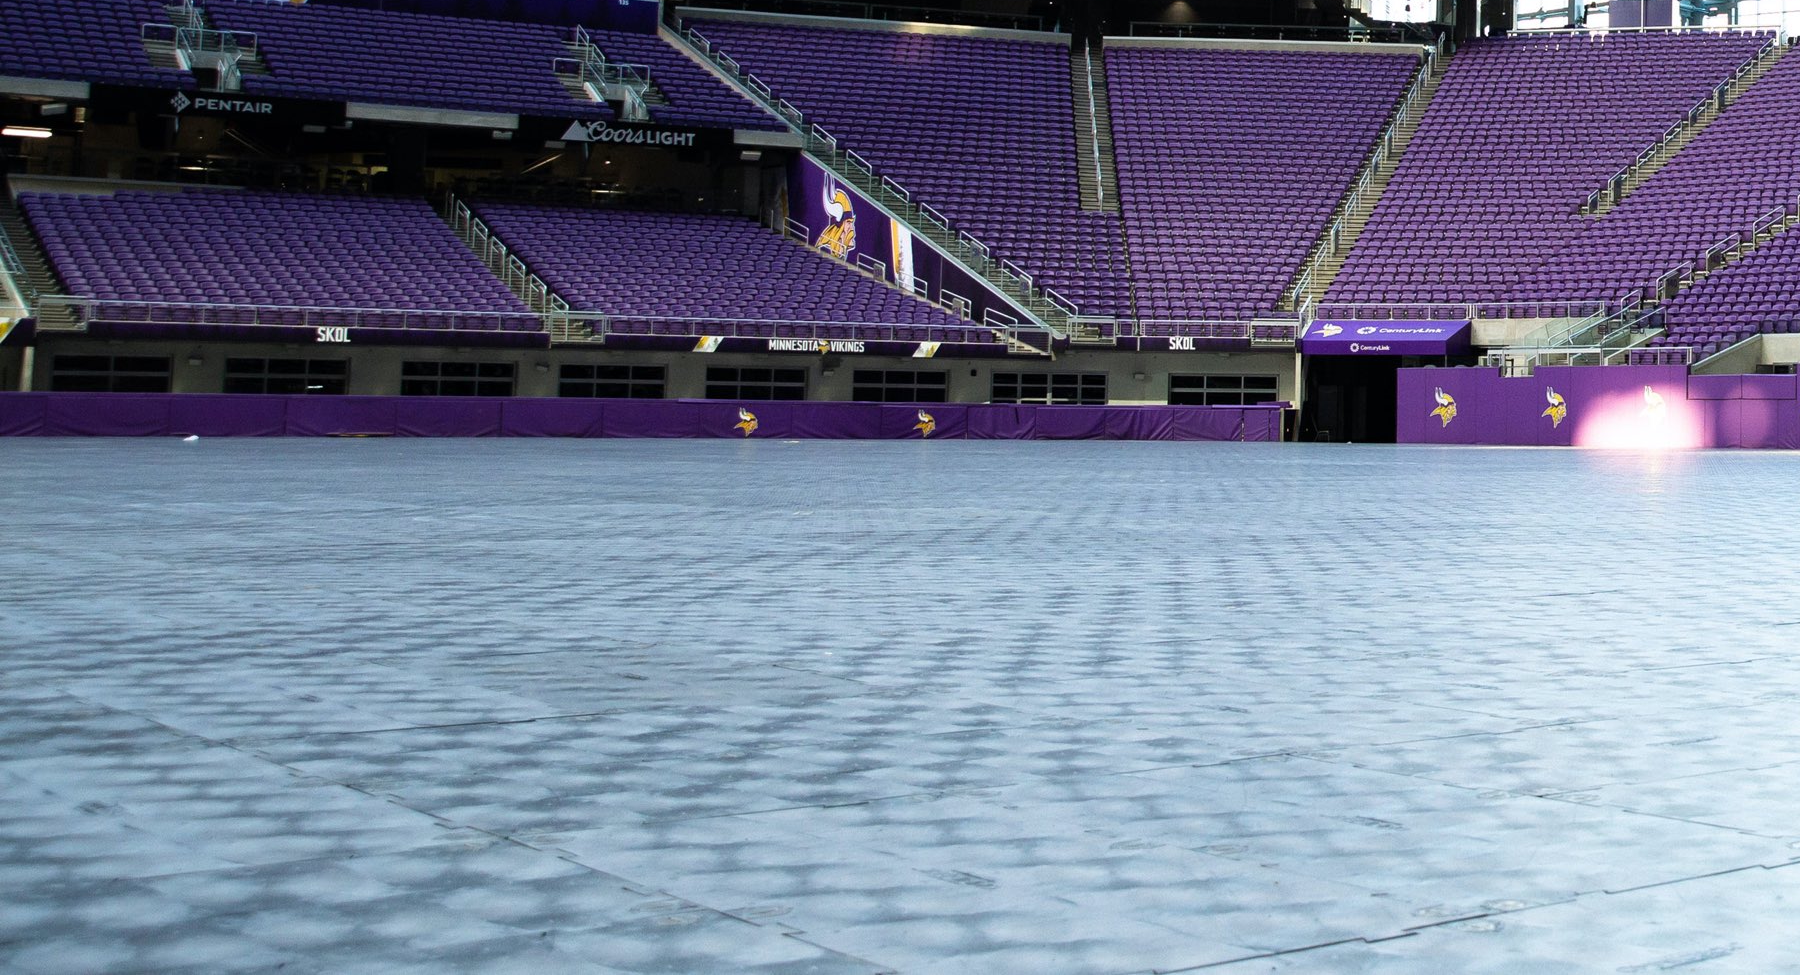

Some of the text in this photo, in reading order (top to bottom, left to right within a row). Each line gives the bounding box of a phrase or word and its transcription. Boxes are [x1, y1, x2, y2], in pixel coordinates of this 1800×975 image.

[195, 98, 273, 114] PENTAIR
[586, 120, 696, 147] Coors LIGHT
[317, 327, 351, 343] SKOL
[1378, 327, 1443, 335] CenturyLink
[768, 339, 865, 353] MINNESOTA VIKINGS
[1169, 337, 1196, 351] SKOL
[1360, 344, 1390, 352] CenturyLink
